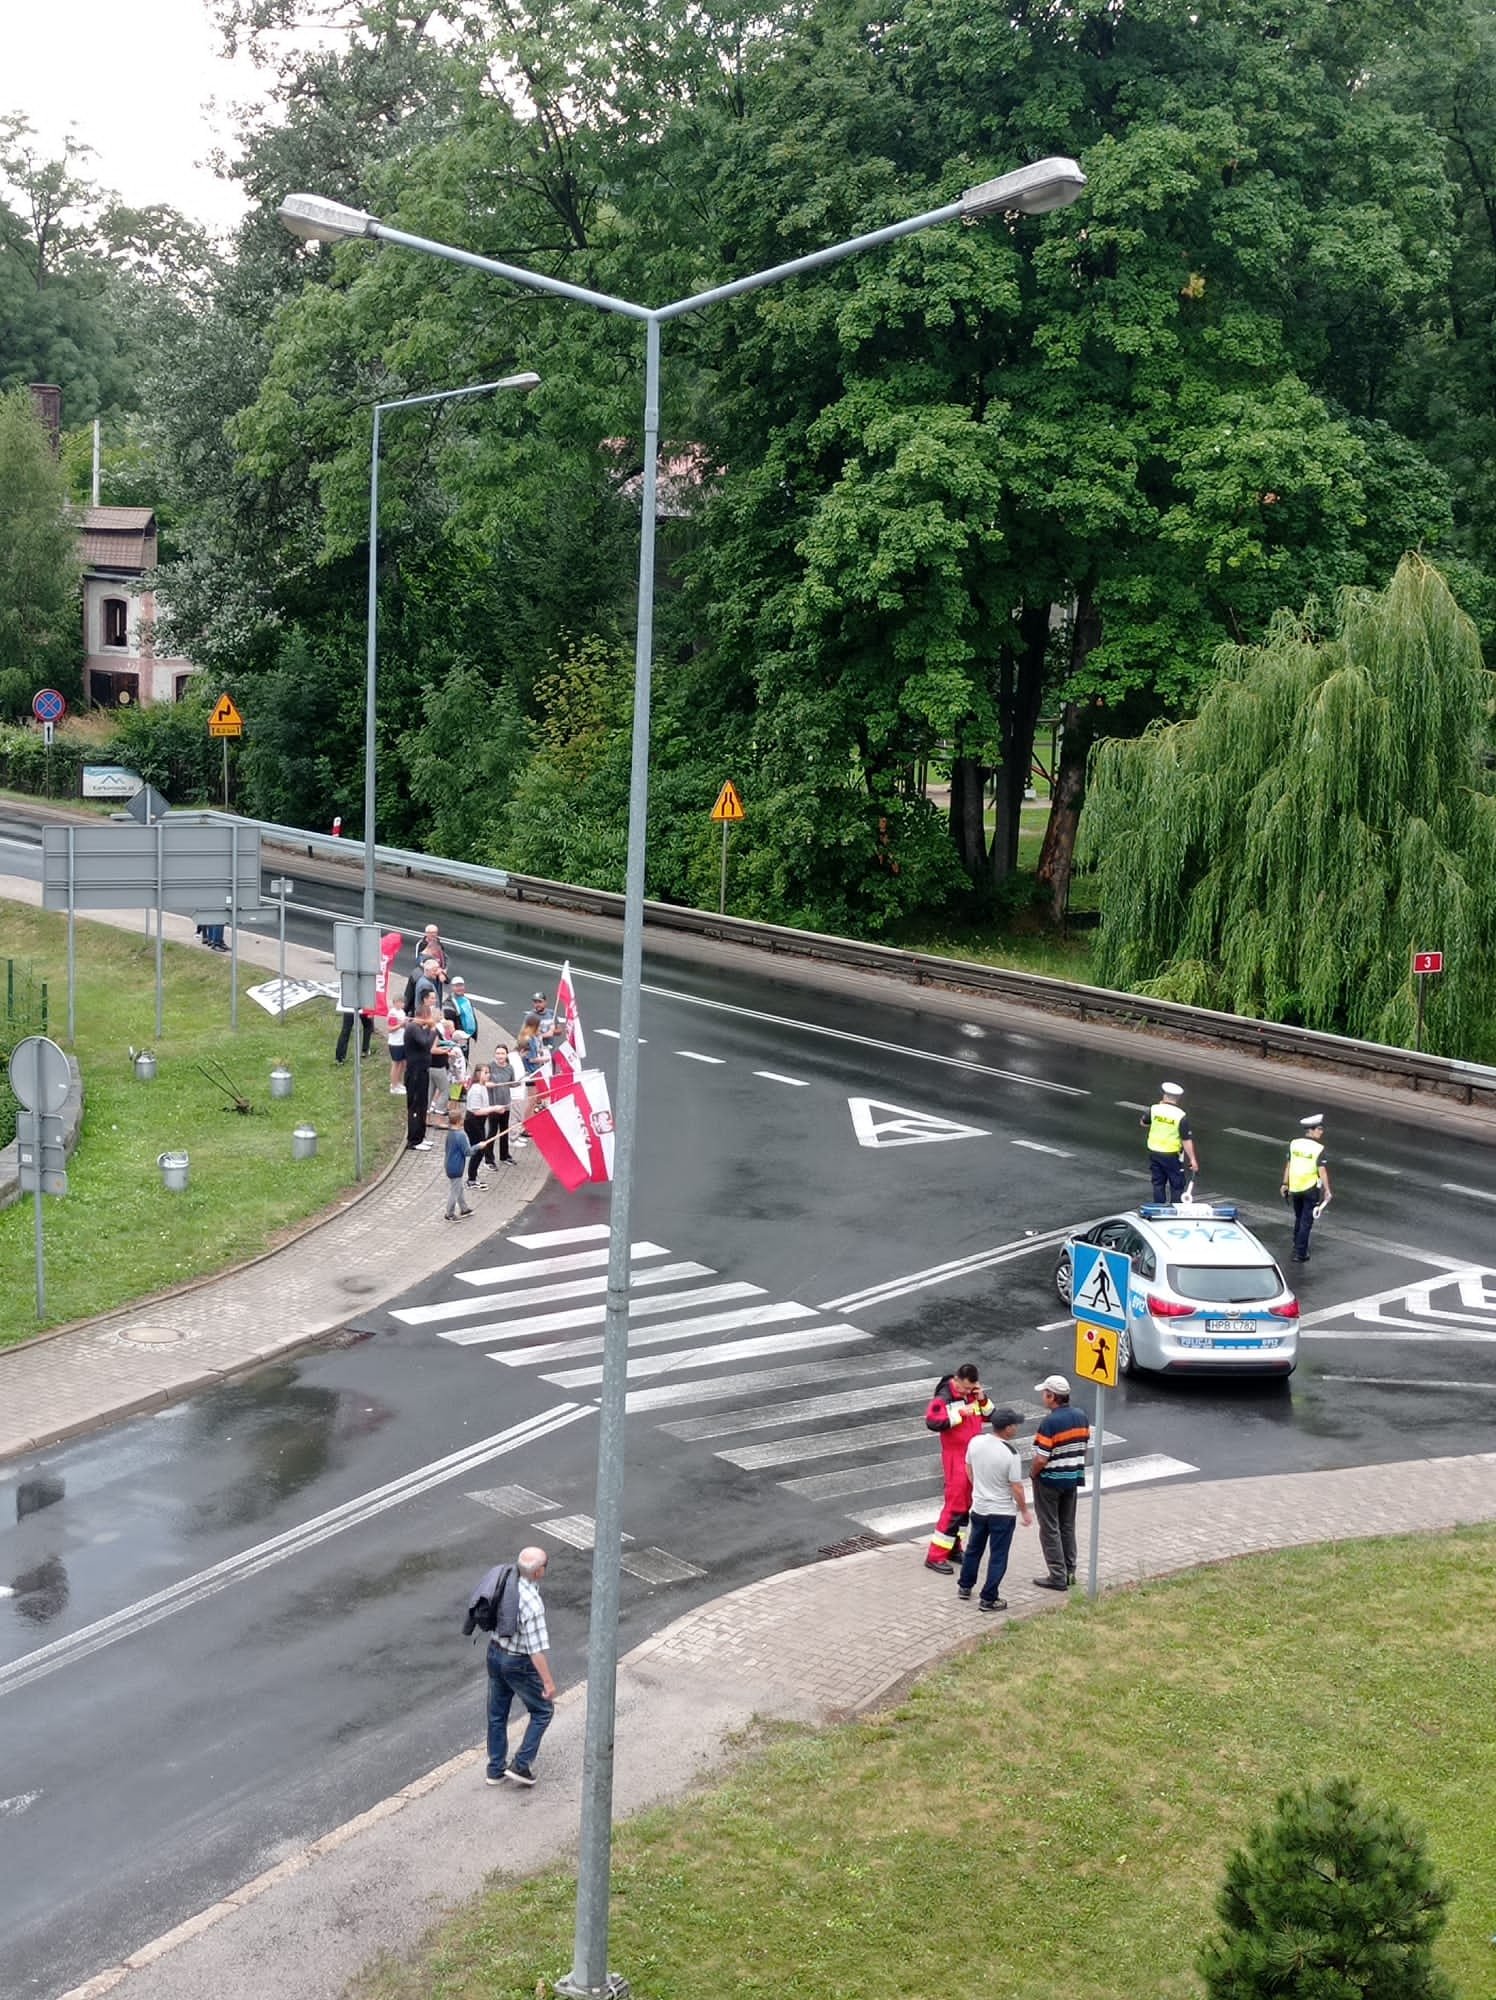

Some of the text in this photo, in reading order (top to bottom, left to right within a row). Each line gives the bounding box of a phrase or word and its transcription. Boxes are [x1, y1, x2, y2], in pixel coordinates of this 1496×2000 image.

[1424, 956, 1431, 968] 3
[1211, 1320, 1230, 1330] HPB
[1180, 1337, 1212, 1345] POLICJA
